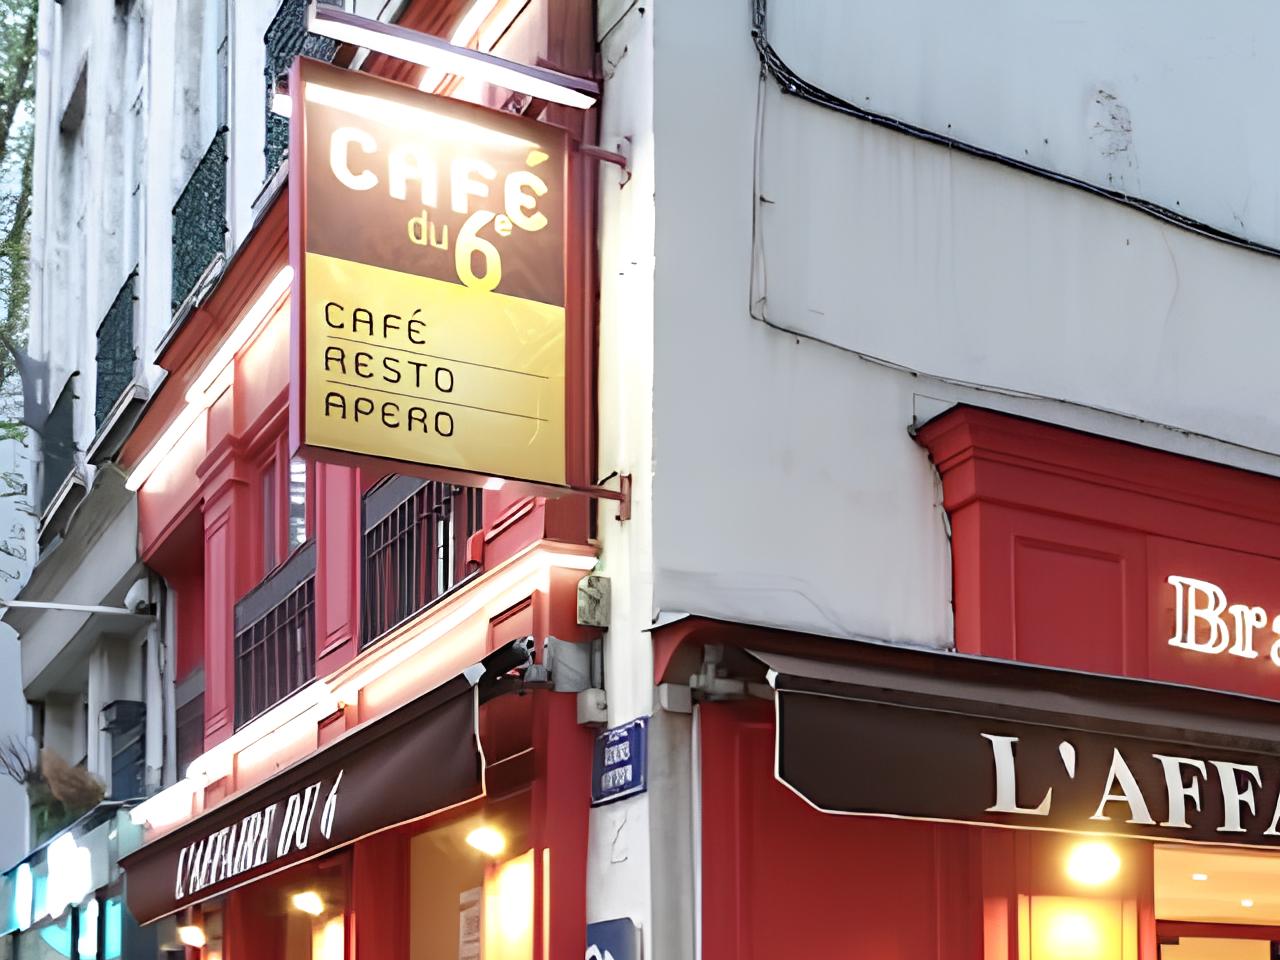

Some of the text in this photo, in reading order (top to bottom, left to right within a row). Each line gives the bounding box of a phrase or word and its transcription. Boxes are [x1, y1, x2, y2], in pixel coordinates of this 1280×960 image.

[330, 126, 549, 232] CAFÉ
[408, 210, 449, 250] du
[325, 302, 428, 345] CAFÉ
[325, 346, 455, 393] RESTO
[325, 392, 455, 438] APERO
[277, 781, 322, 858] DU
[320, 769, 343, 840] 6
